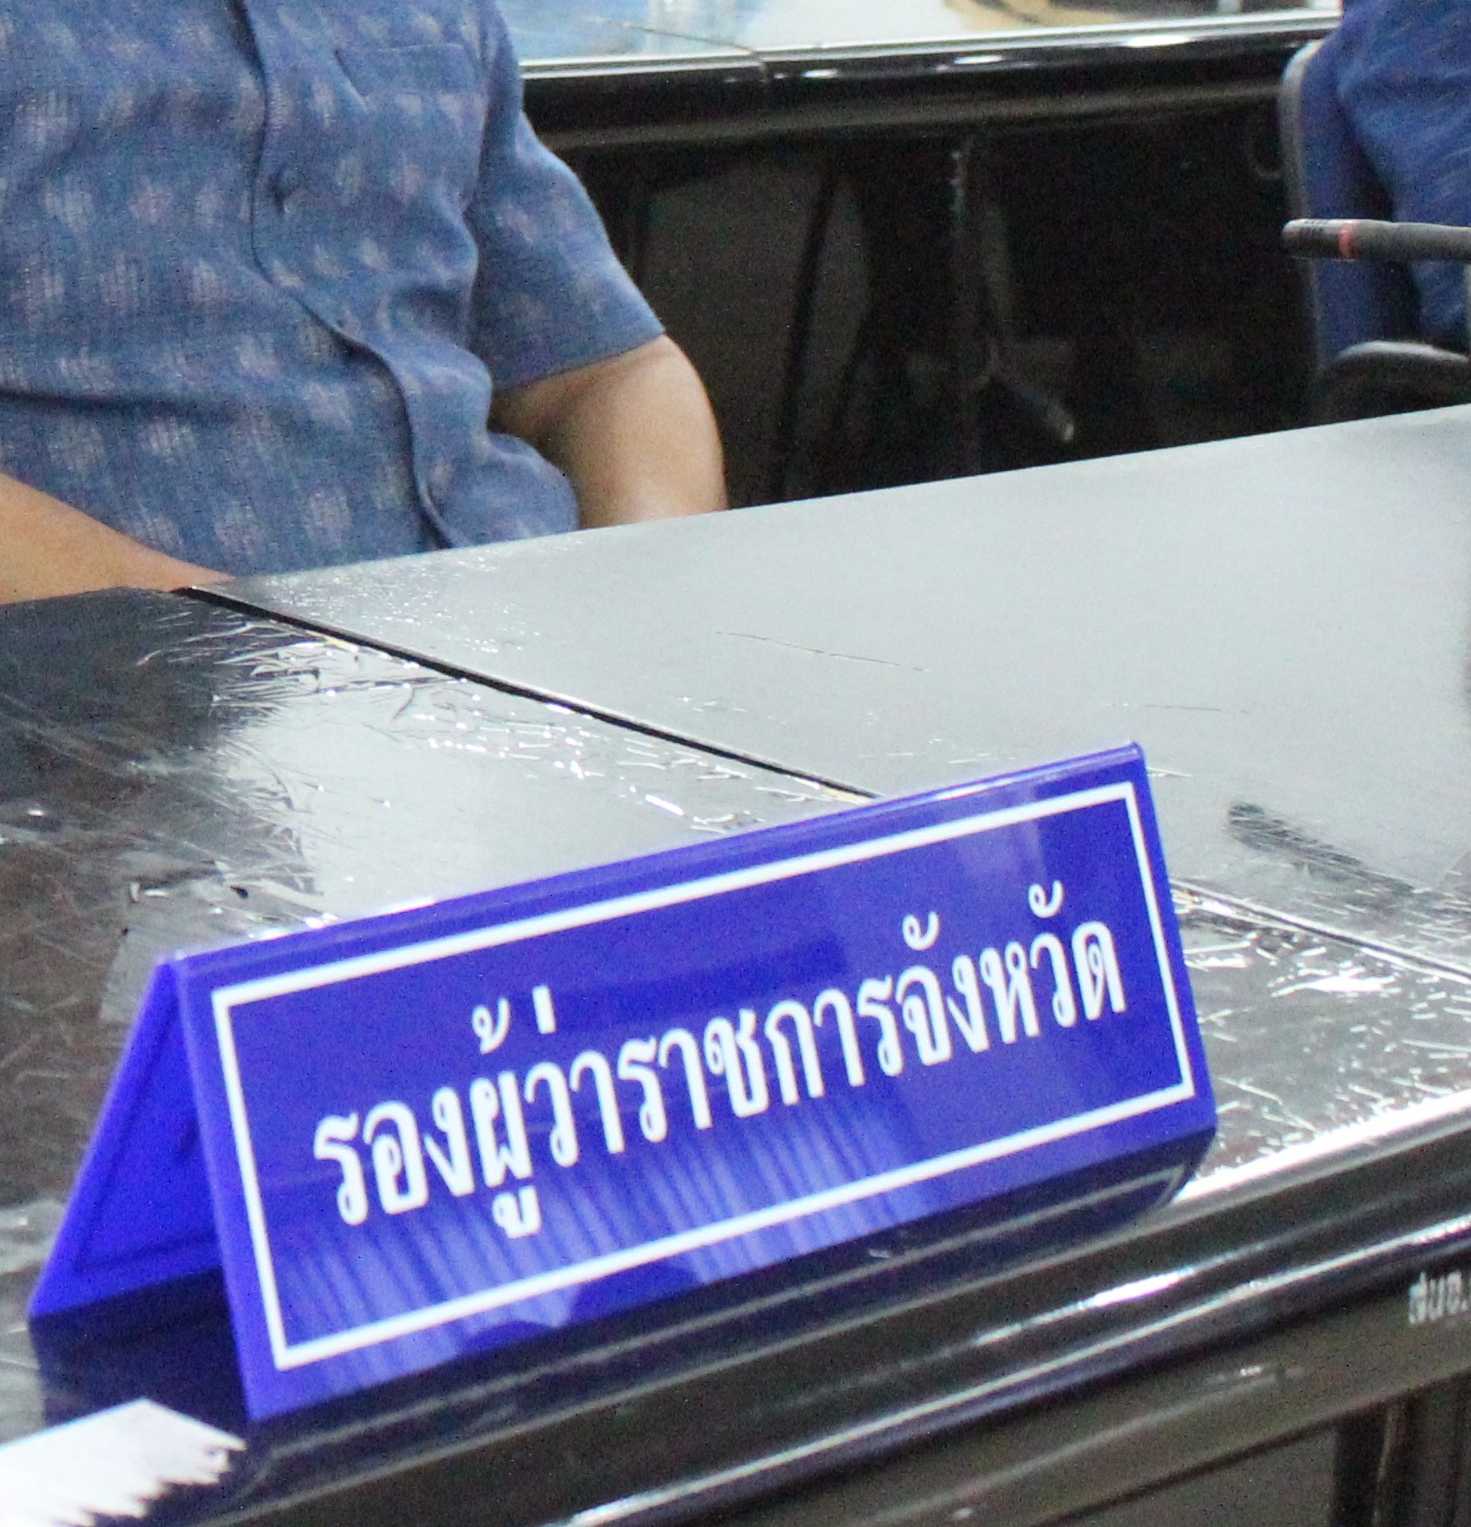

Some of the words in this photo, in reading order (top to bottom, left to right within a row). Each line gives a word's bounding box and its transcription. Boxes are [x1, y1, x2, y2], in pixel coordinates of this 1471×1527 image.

[313, 879, 1126, 1240] รองผู้ว่าราชการจังหวัด
